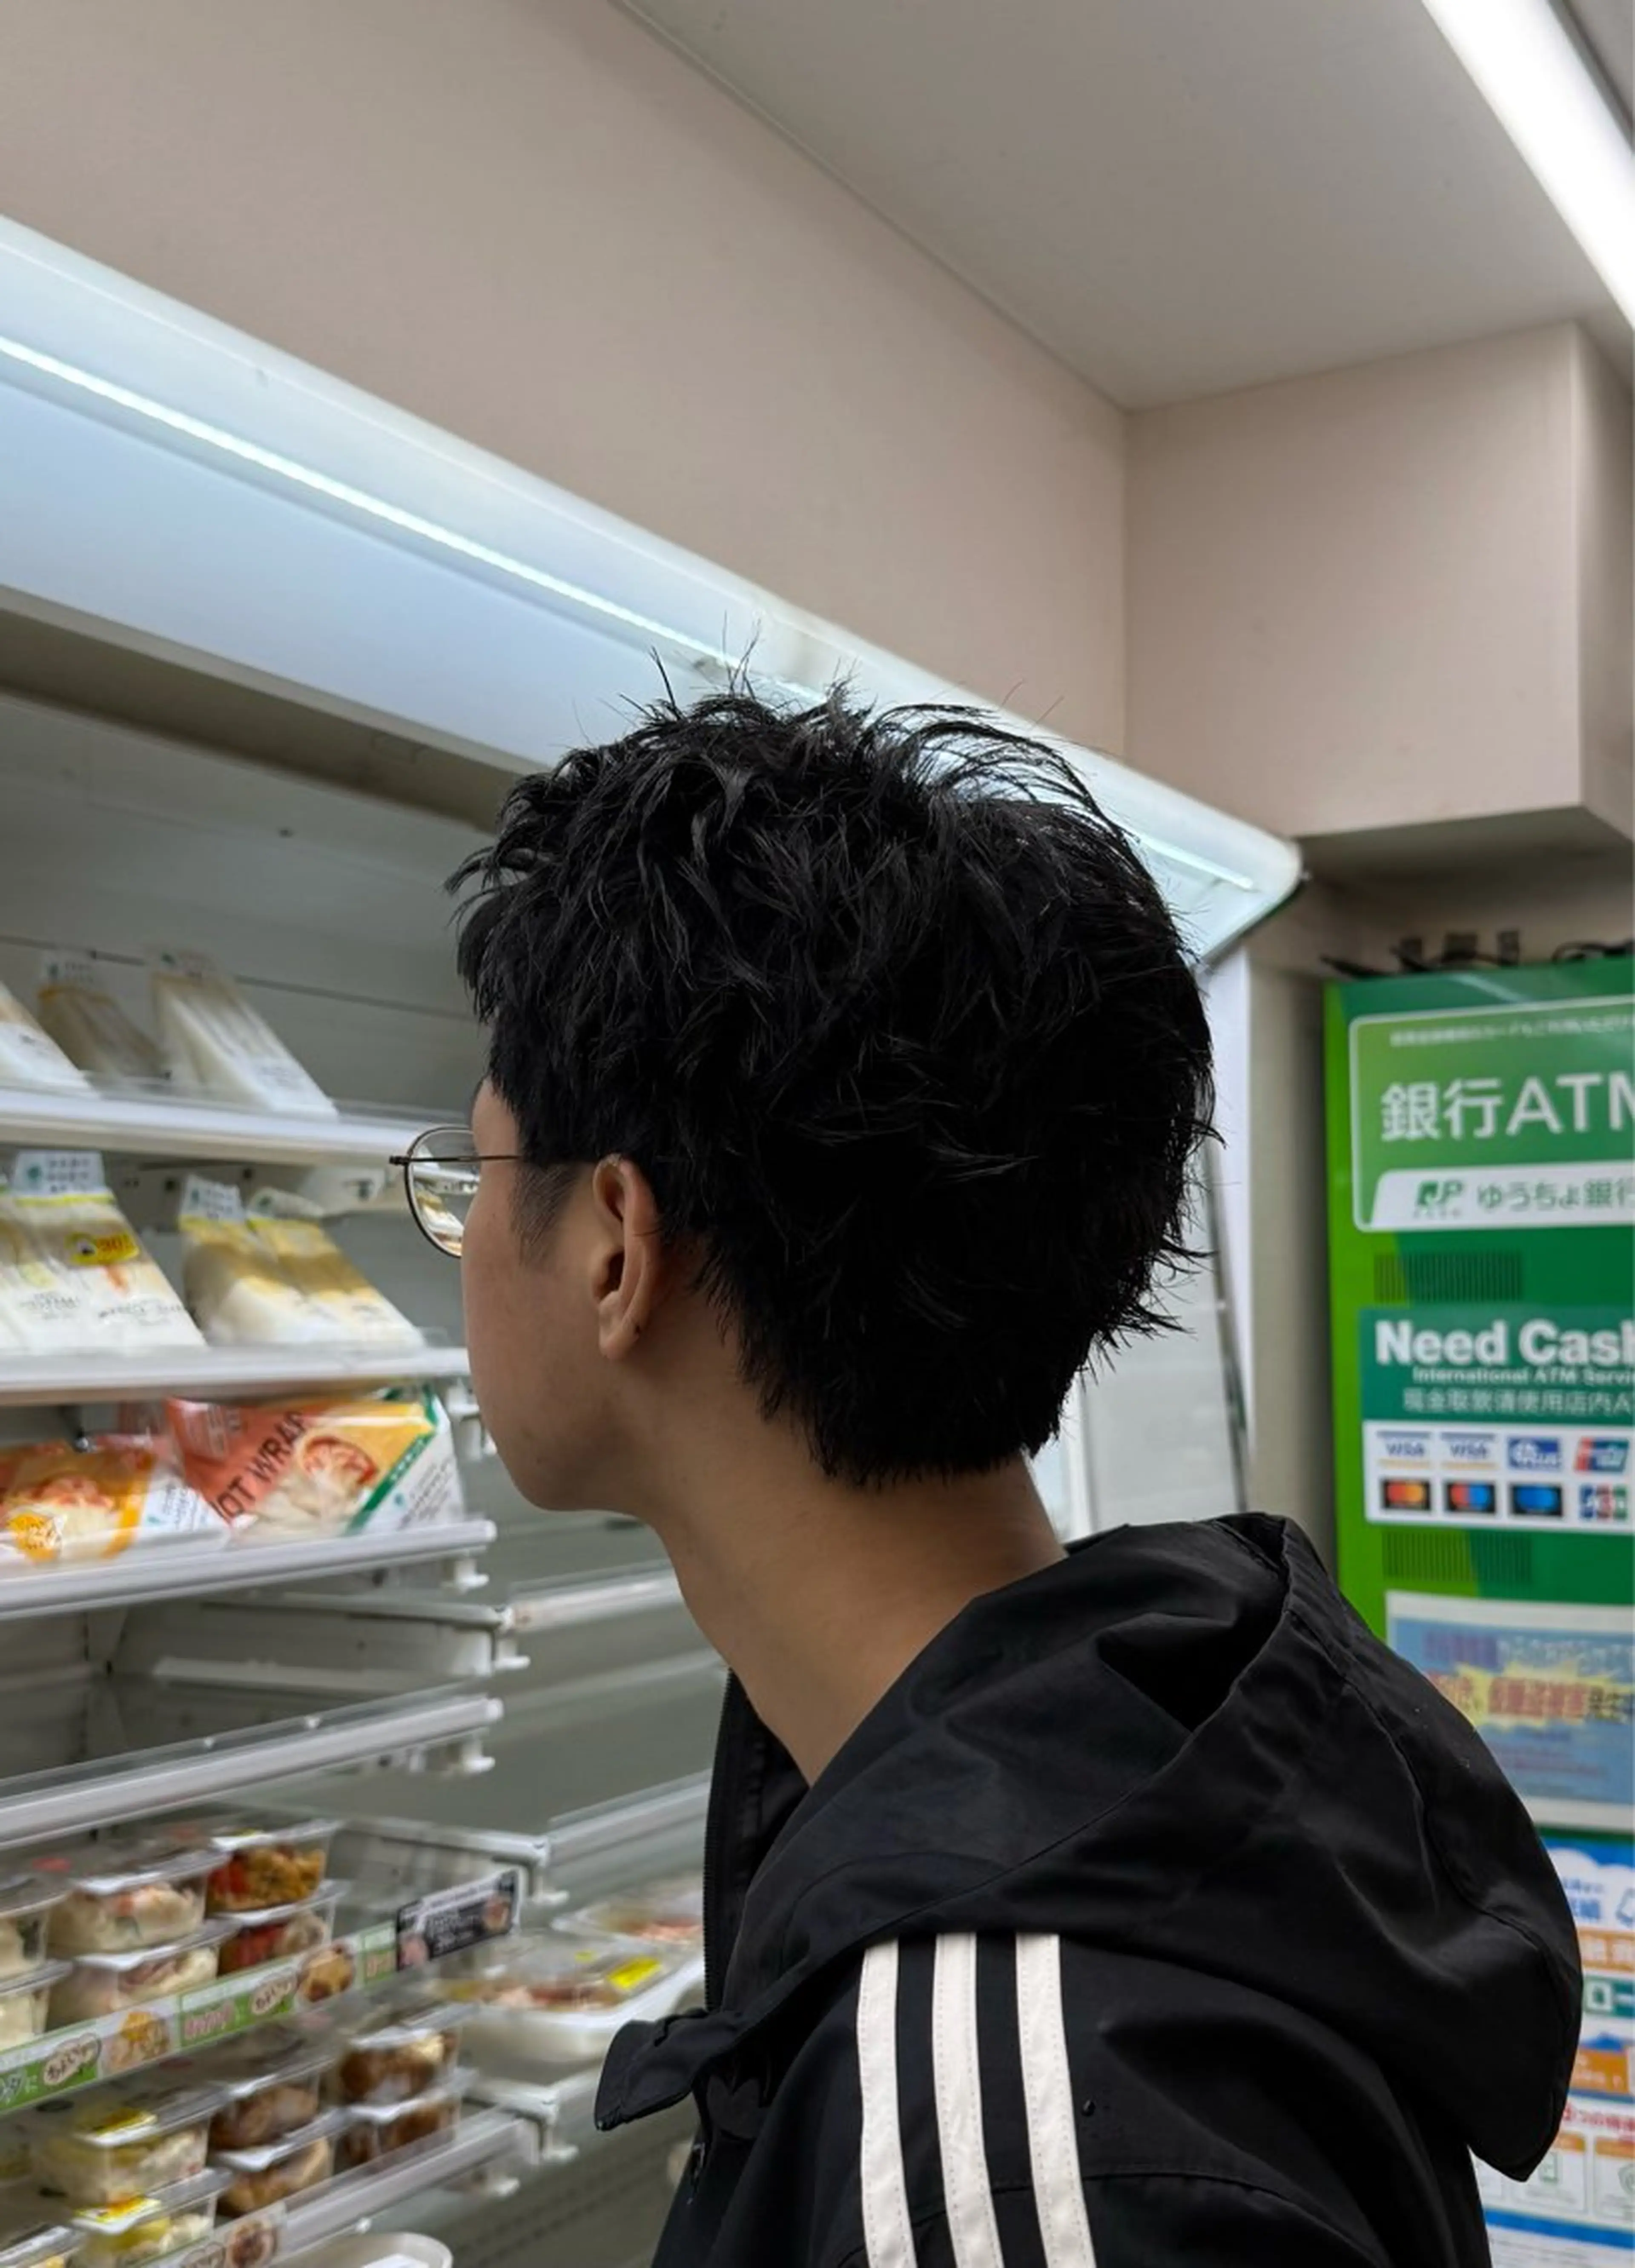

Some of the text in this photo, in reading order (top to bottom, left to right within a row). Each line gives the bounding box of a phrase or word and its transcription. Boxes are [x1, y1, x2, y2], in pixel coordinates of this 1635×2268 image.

[1375, 1320, 1508, 1365] Need
[1412, 1366, 1529, 1385] International
[1534, 1367, 1577, 1384] ATM
